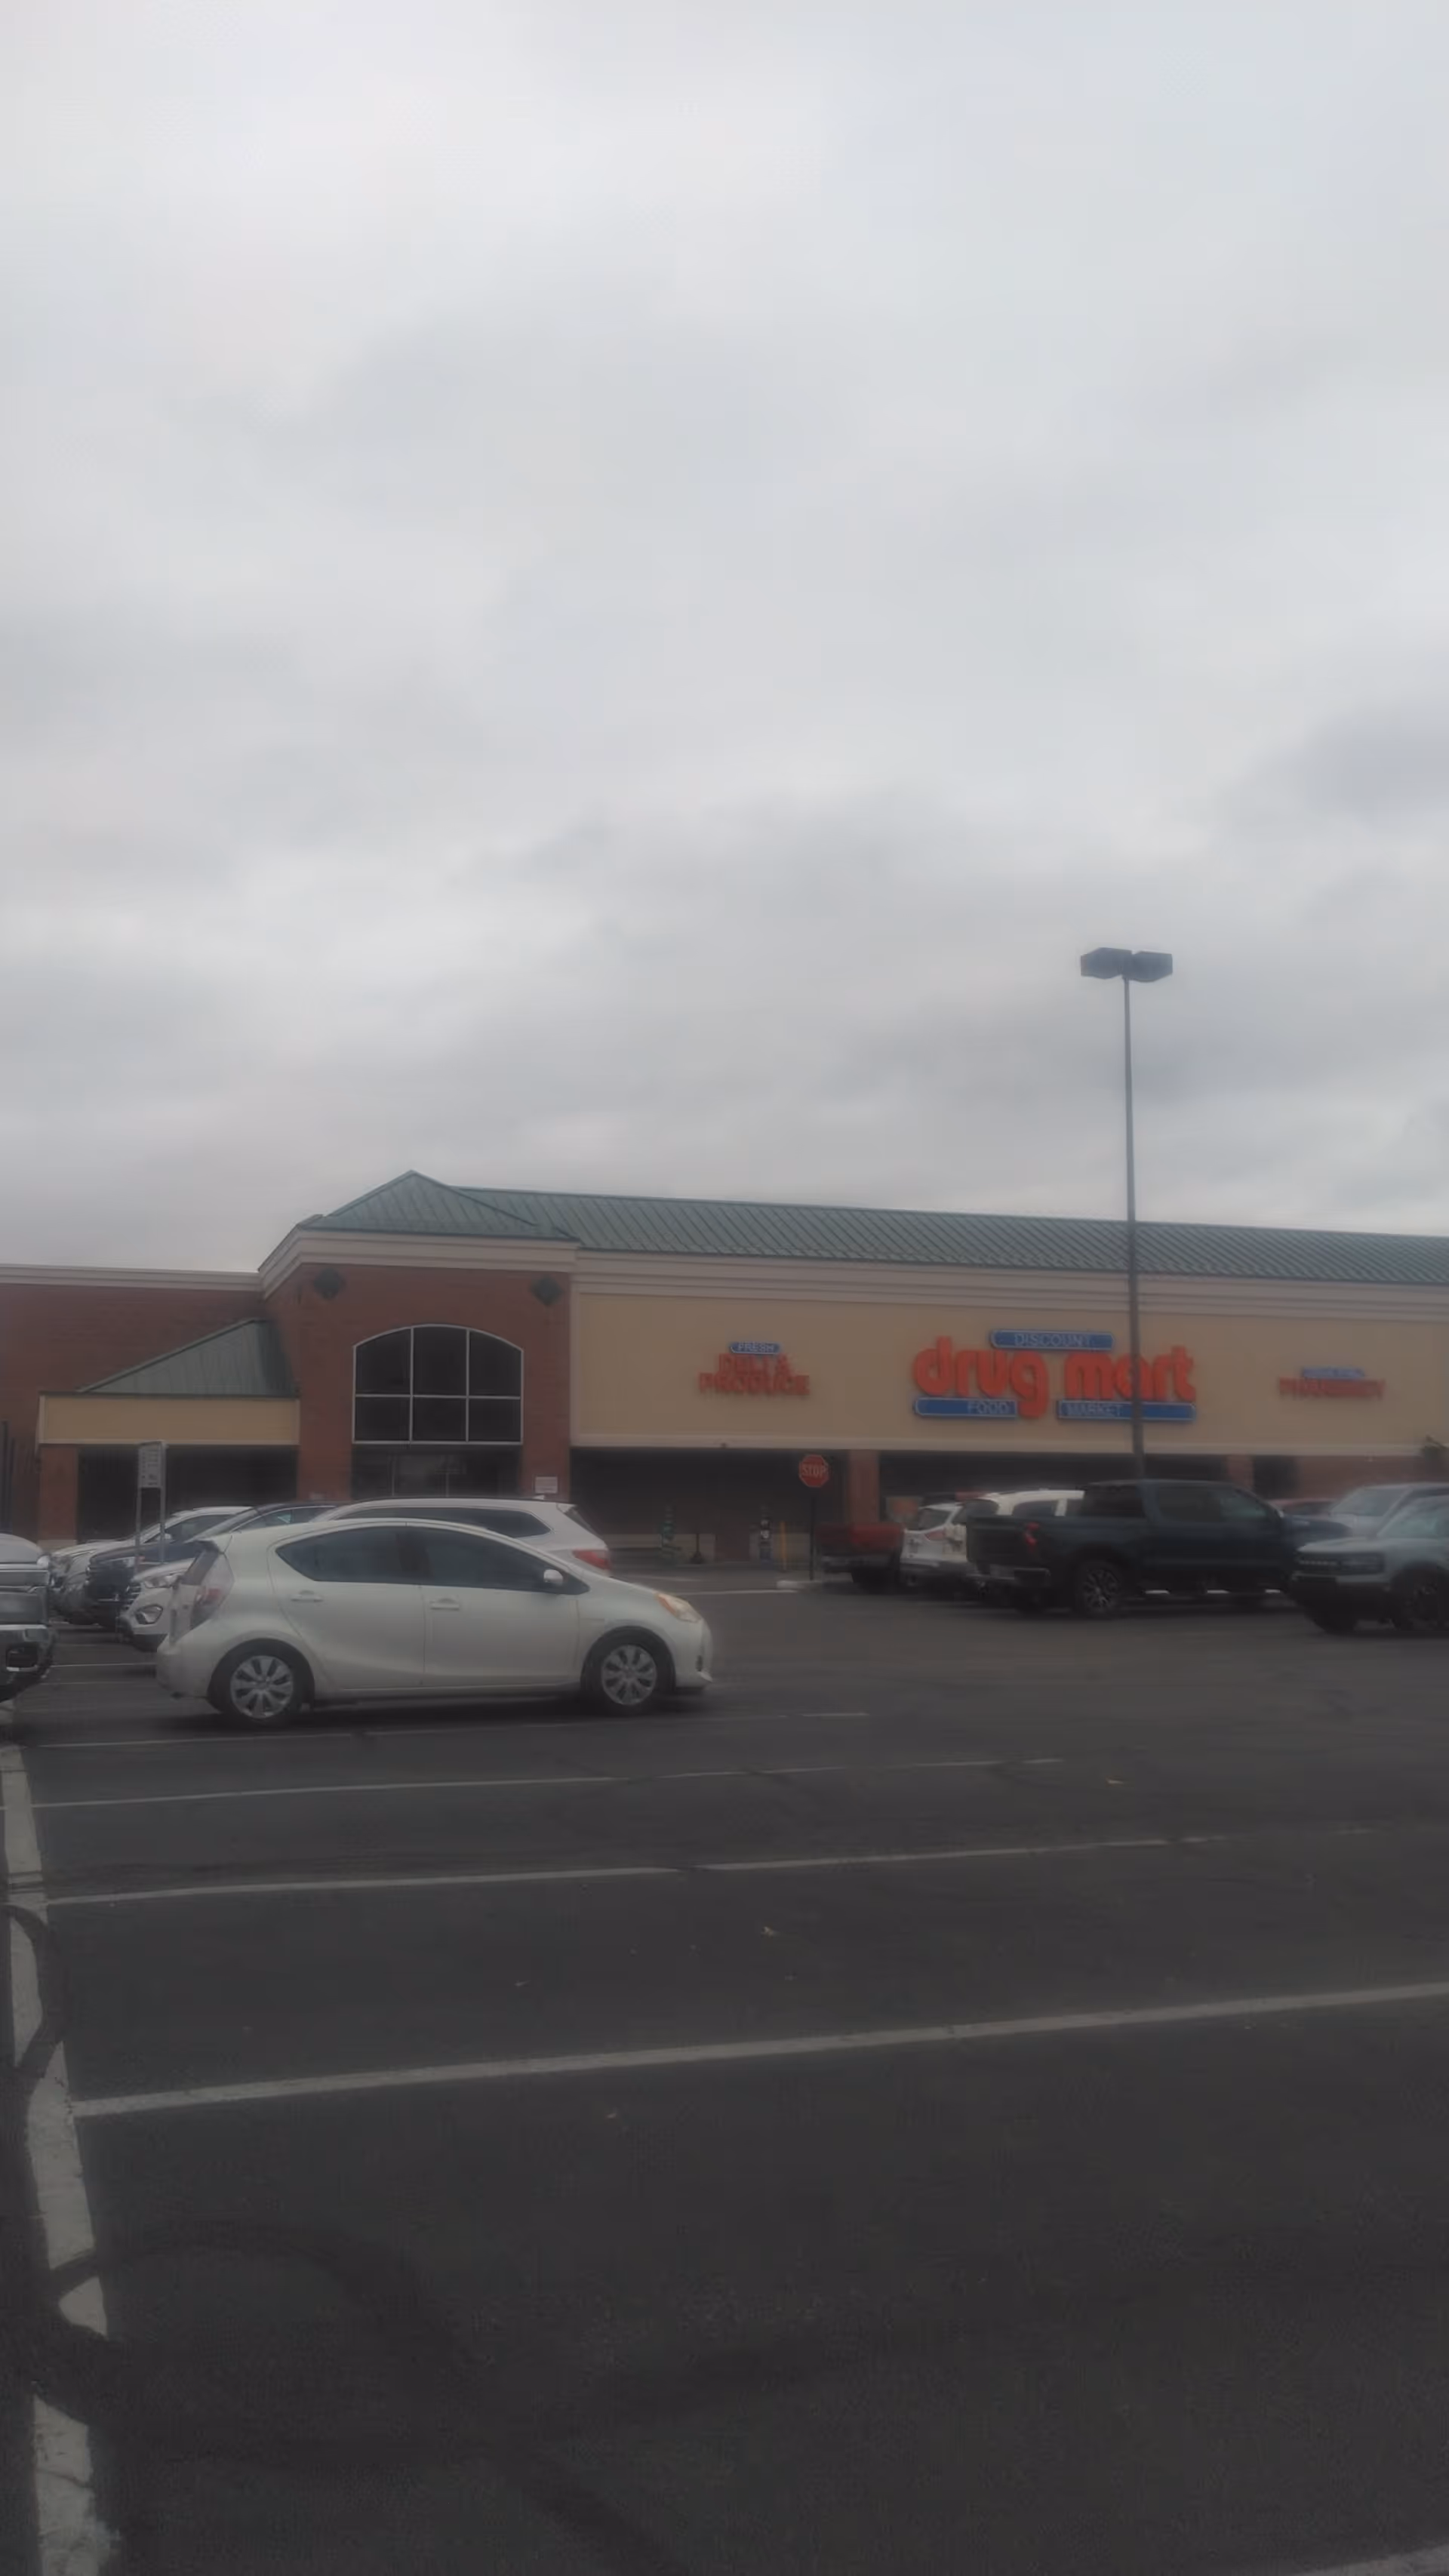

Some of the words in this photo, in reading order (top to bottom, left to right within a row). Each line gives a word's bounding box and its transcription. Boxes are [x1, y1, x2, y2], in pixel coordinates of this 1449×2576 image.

[1015, 1333, 1092, 1347] DISCOUNT
[737, 1342, 775, 1353] FRESH
[913, 1335, 1048, 1419] drug
[1064, 1346, 1196, 1400] mart
[968, 1401, 1009, 1415] FOOD
[1066, 1402, 1123, 1417] MARKET
[802, 1464, 827, 1478] STOP
